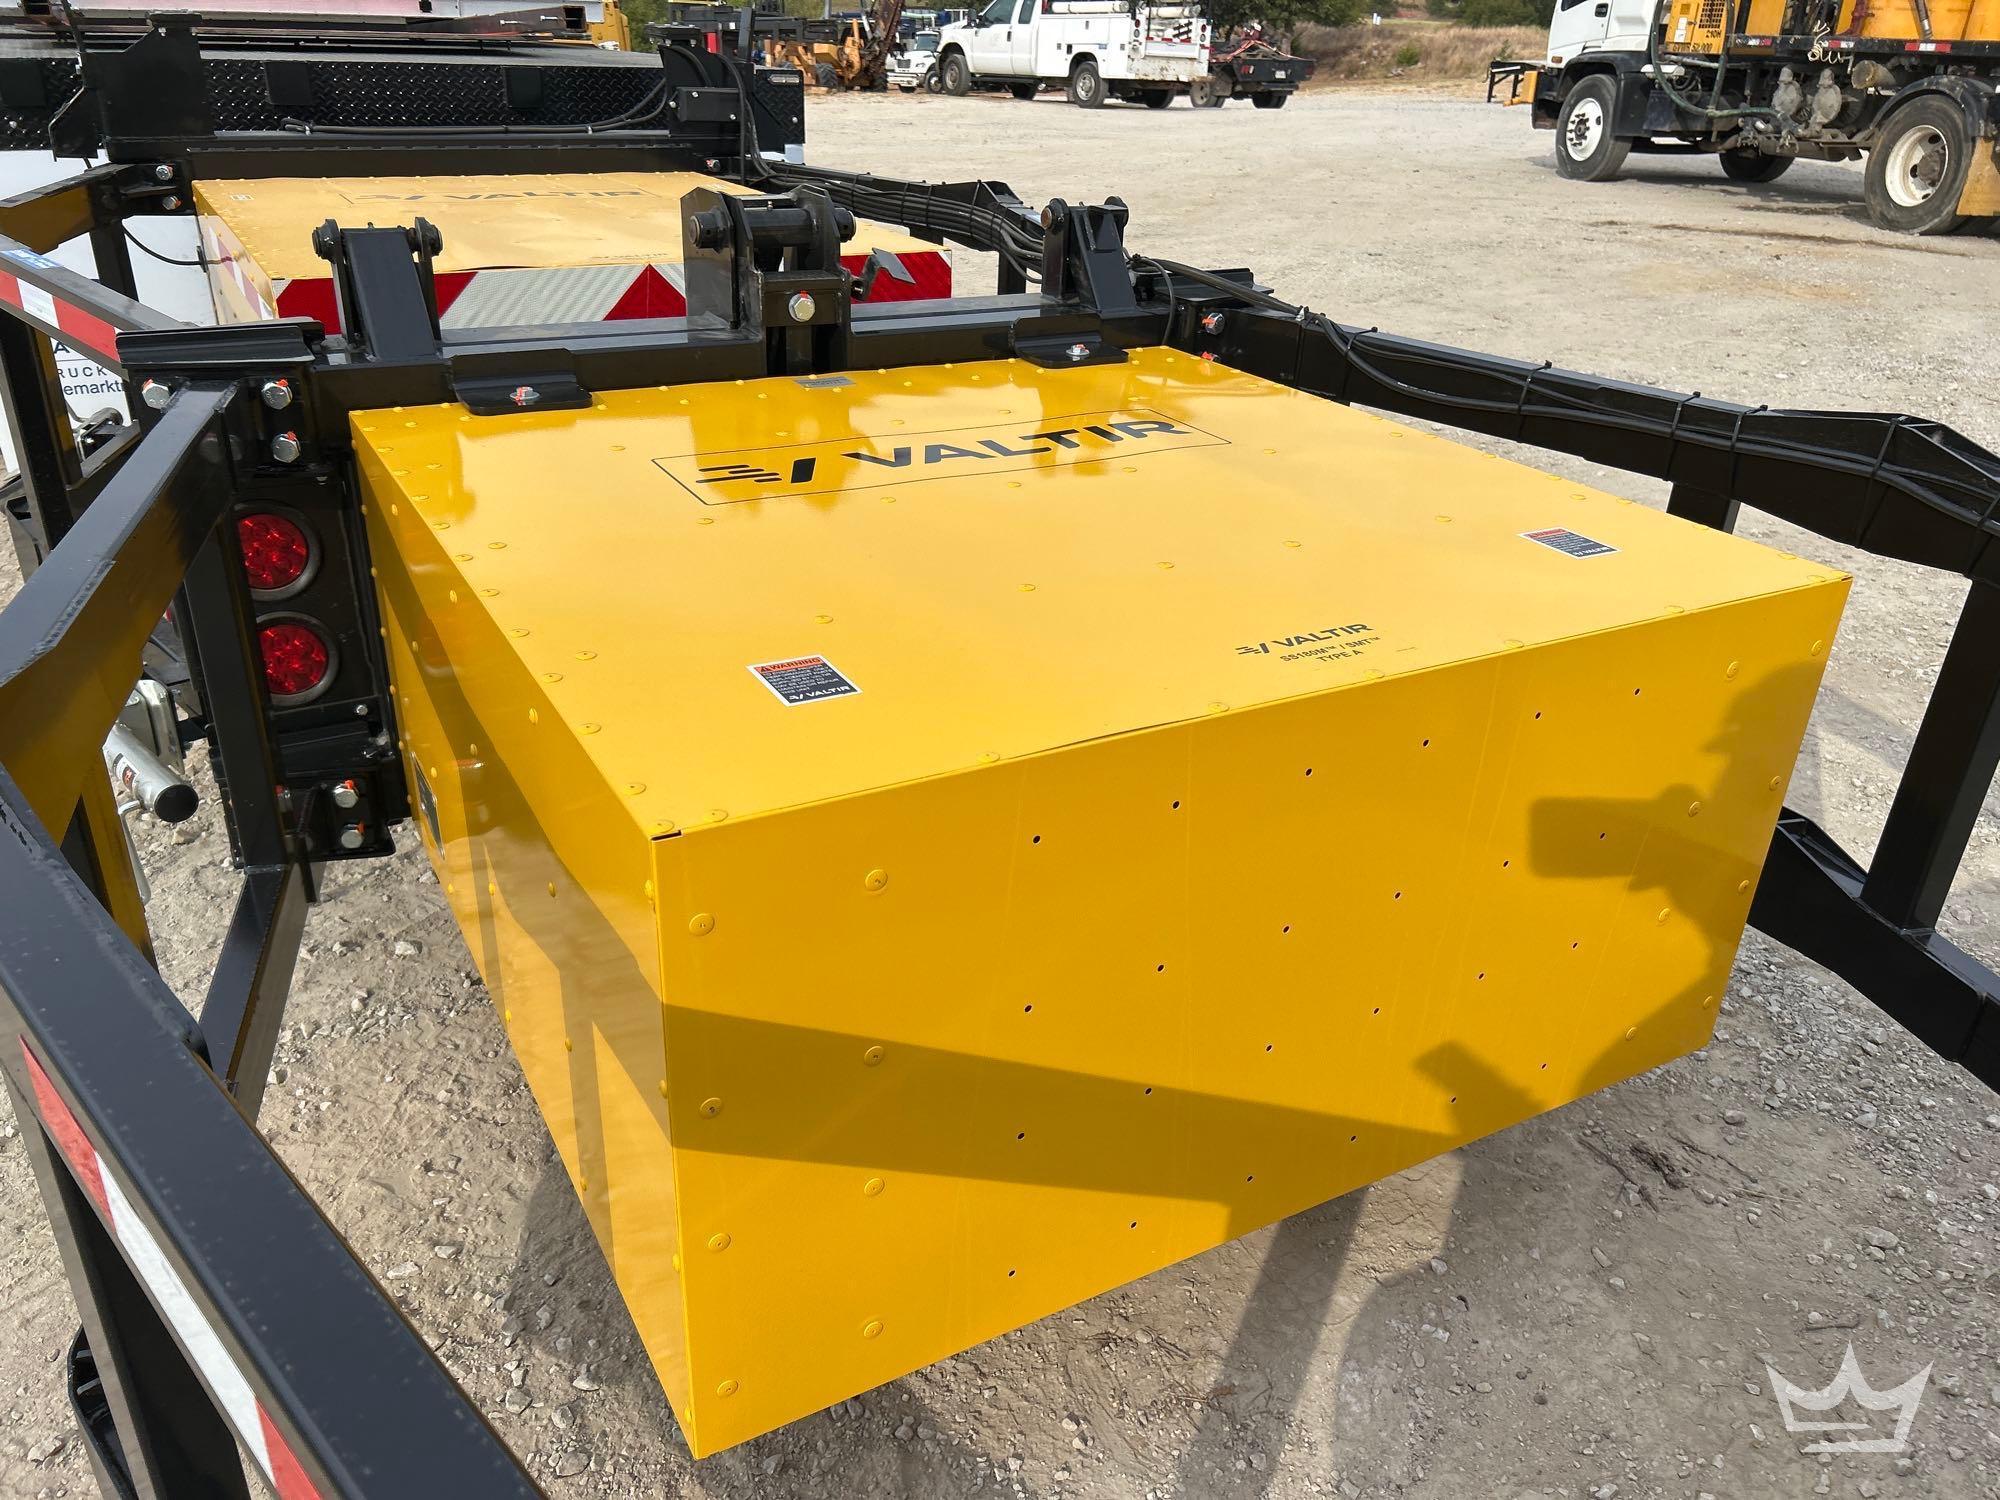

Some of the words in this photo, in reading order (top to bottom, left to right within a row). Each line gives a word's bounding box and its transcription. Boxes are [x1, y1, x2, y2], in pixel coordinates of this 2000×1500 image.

[63, 380, 123, 395] emarkt
[842, 419, 1190, 468] VALTIR
[1271, 623, 1373, 647] VALTIR
[1316, 651, 1351, 662] TYPE
[806, 686, 851, 697] VALTIR
